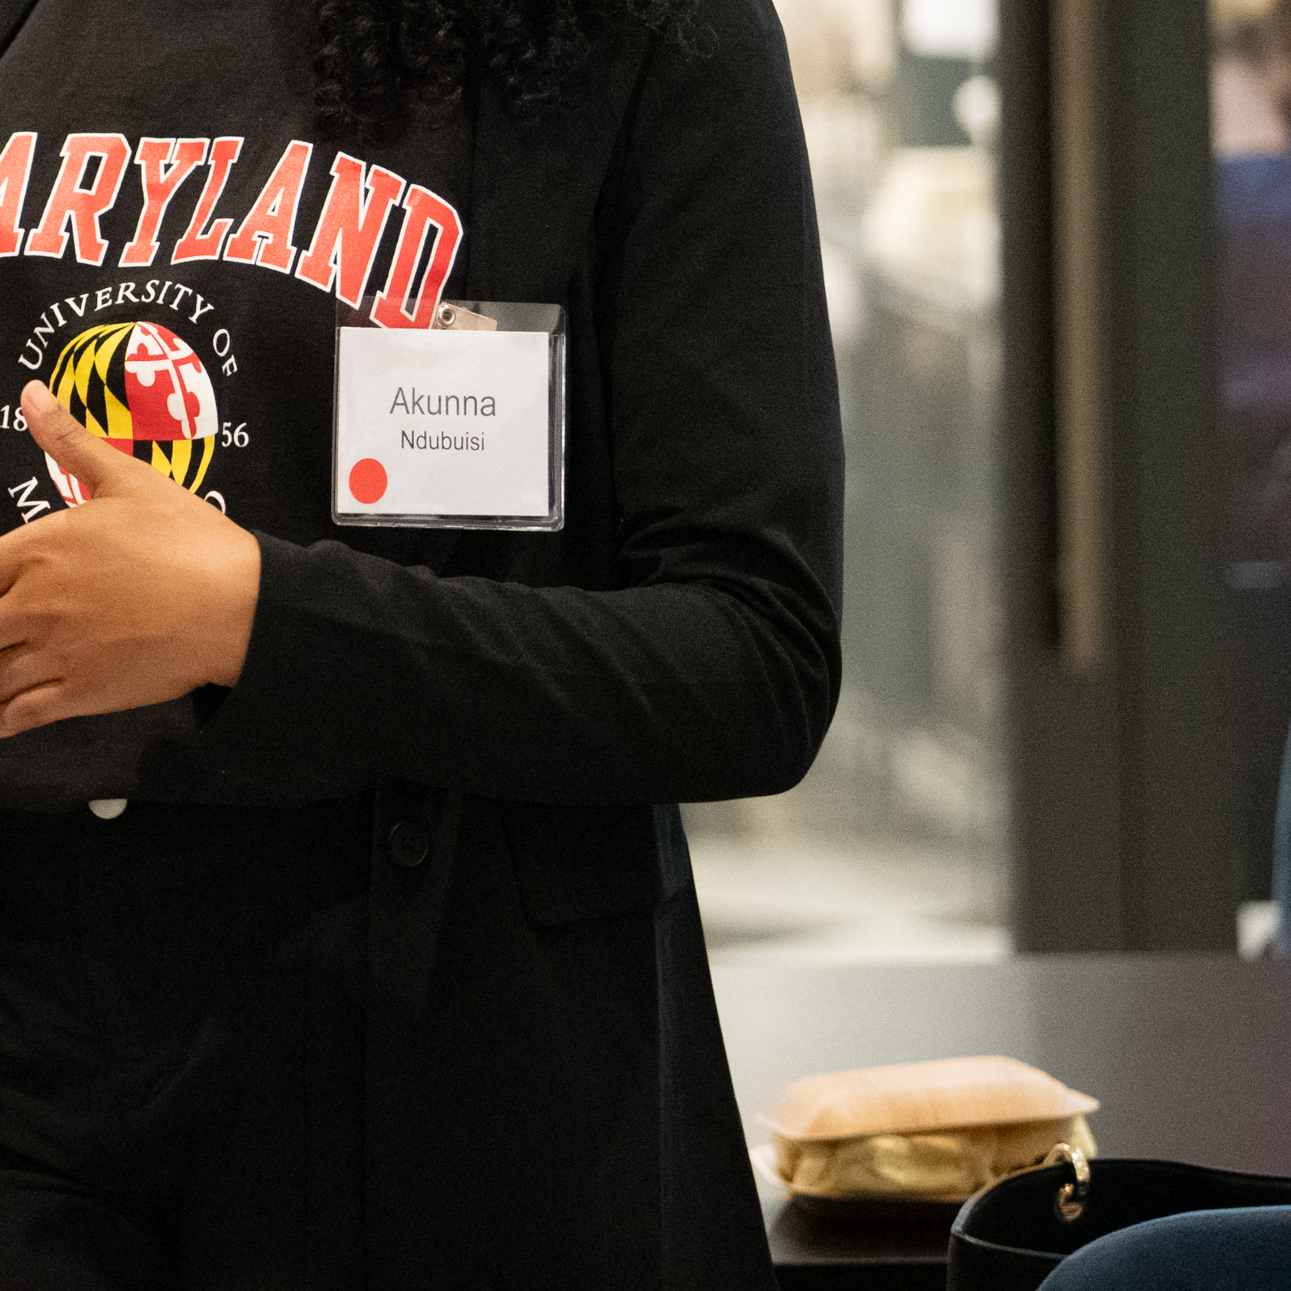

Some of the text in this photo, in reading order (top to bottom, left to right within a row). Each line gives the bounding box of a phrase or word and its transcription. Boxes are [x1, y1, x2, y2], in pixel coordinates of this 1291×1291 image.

[18, 279, 238, 377] UNIVERSITY OF
[389, 386, 496, 417] Akunna
[0, 404, 28, 432] 18
[221, 422, 250, 448] 56
[401, 430, 485, 451] Ndubuisi
